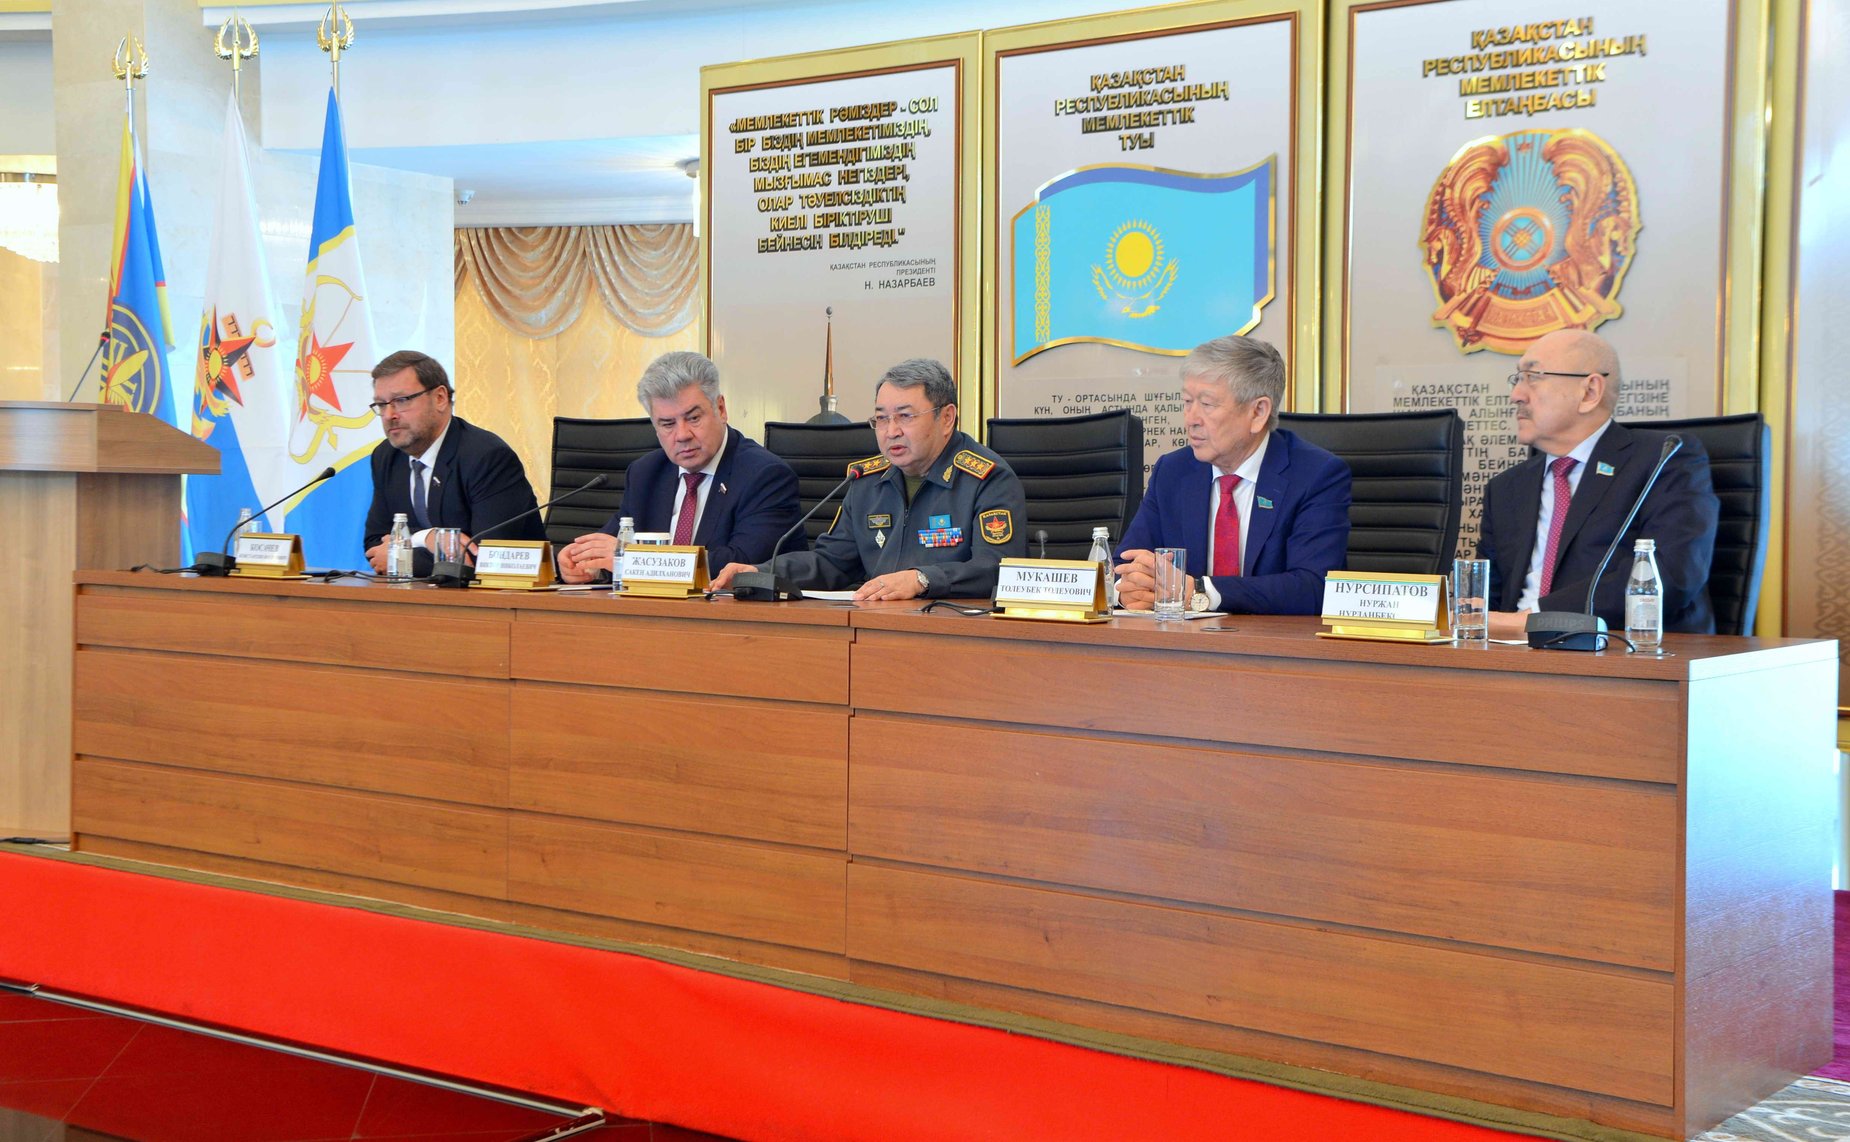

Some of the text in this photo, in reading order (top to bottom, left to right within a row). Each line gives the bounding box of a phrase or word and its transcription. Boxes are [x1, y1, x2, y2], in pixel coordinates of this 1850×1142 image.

[1471, 16, 1593, 50] ҚАЗАҚСТАН
[1423, 35, 1647, 77] РЕСПУБЛИКАСЫНЫҢ
[1091, 65, 1185, 92] ҚАЗАҚСТАН
[1460, 62, 1606, 96] МЕМЛЕКЕТТІК
[1055, 81, 1229, 116] РЕСПУБЛИКАСЫНЫҢ
[1465, 89, 1596, 119] ЕЛТАҢБАСЫ
[830, 100, 897, 123] РӘМІЗДЕР
[908, 96, 938, 114] СОЛ
[1082, 106, 1194, 134] МЕМЛЕКЕТТІК
[735, 137, 756, 153] БІР
[761, 133, 804, 151] БІЗДІҢ
[1119, 132, 1154, 151] ТУЫ
[750, 155, 791, 172] БІЗДІҢ
[754, 171, 832, 192] МЫЗҒЫМАС
[758, 186, 906, 212] ОЛАР ТӘУЕЛСІЗДІКТІҢ
[770, 208, 892, 232] КИЕЛІ БІРІКТІРУШІ
[758, 235, 823, 254] БЕЙНЕСІН
[830, 258, 936, 271] ҚАЗАҚСТАН РЕСПУБЛИКАСЫНЫҢ
[896, 267, 936, 276] ПРЕЗИДЕНТІ
[865, 278, 935, 290] Н. НАЗАРБАЕВ
[1052, 395, 1063, 403] ТУ
[1075, 393, 1136, 402] ОРТАСЫНДА
[1145, 392, 1184, 401] ШҰҒЫЛ
[1412, 384, 1489, 396] ҚАЗАҚСТАН
[1063, 406, 1091, 415] ОНЫҢ
[1155, 404, 1185, 414] ҚАЛЫ
[1393, 396, 1480, 407] МЕМЛЕКЕТТІК
[632, 557, 686, 567] ЖАСУЗАКОВ
[1016, 571, 1078, 583] МУКАШЕВ
[1001, 585, 1091, 596] ТОЛЕУБЕК ТОЛЕУОВИЧ
[1335, 583, 1428, 597] НУРСИПАТОВ
[1537, 618, 1585, 628] PHILIPS
